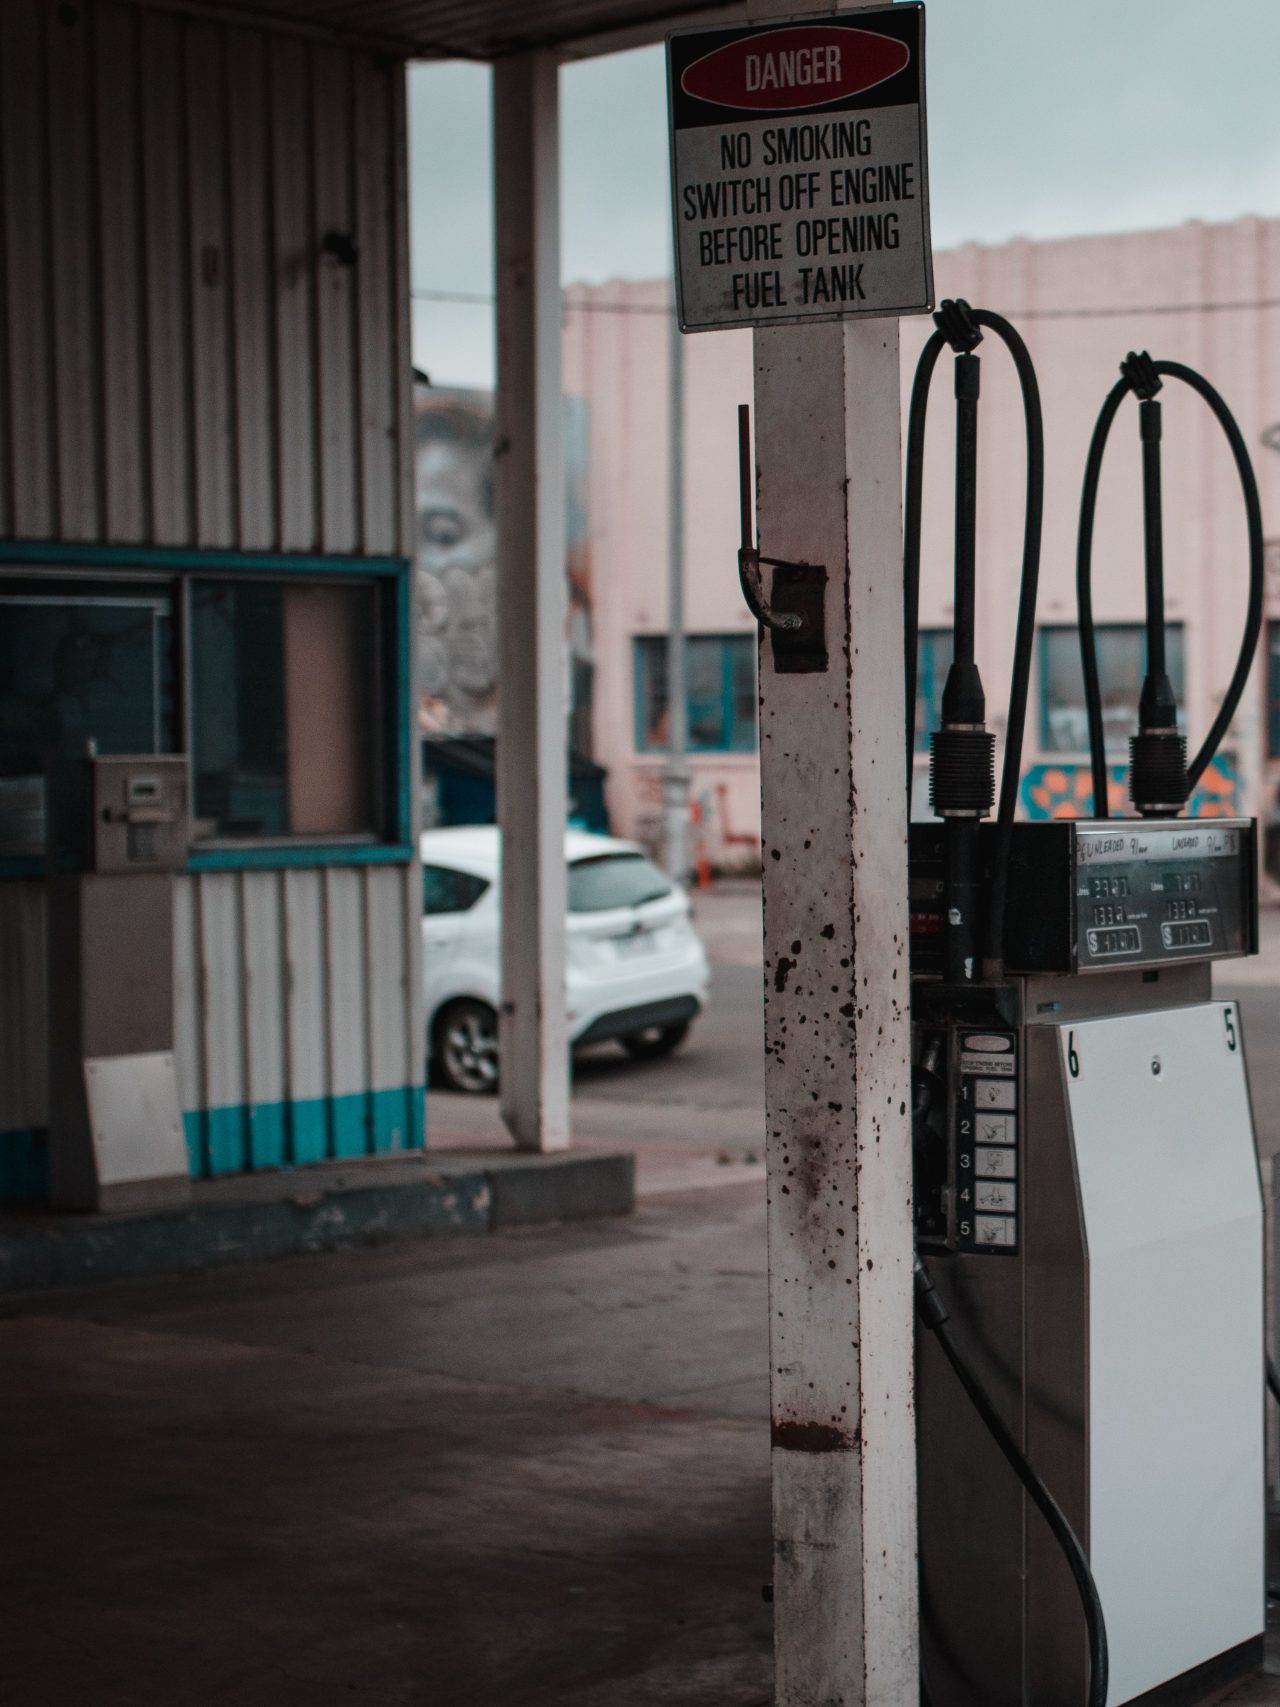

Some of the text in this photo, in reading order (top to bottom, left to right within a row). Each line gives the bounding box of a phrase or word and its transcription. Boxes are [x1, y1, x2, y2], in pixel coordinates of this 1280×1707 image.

[745, 45, 841, 91] DANGER
[720, 119, 871, 170] NO SMOKING
[683, 163, 914, 221] SWITCH OFF ENGINE
[700, 212, 899, 266] BEFORE OPENING
[732, 263, 866, 310] FUEL TANK
[1088, 932, 1099, 952] $
[1163, 926, 1173, 945] $
[1223, 1008, 1237, 1051] 5
[1067, 1030, 1079, 1078] 6
[961, 1086, 968, 1100] 1
[960, 1121, 970, 1134] 2
[960, 1154, 970, 1168] 3
[960, 1188, 970, 1202] 4
[960, 1221, 970, 1235] 5
